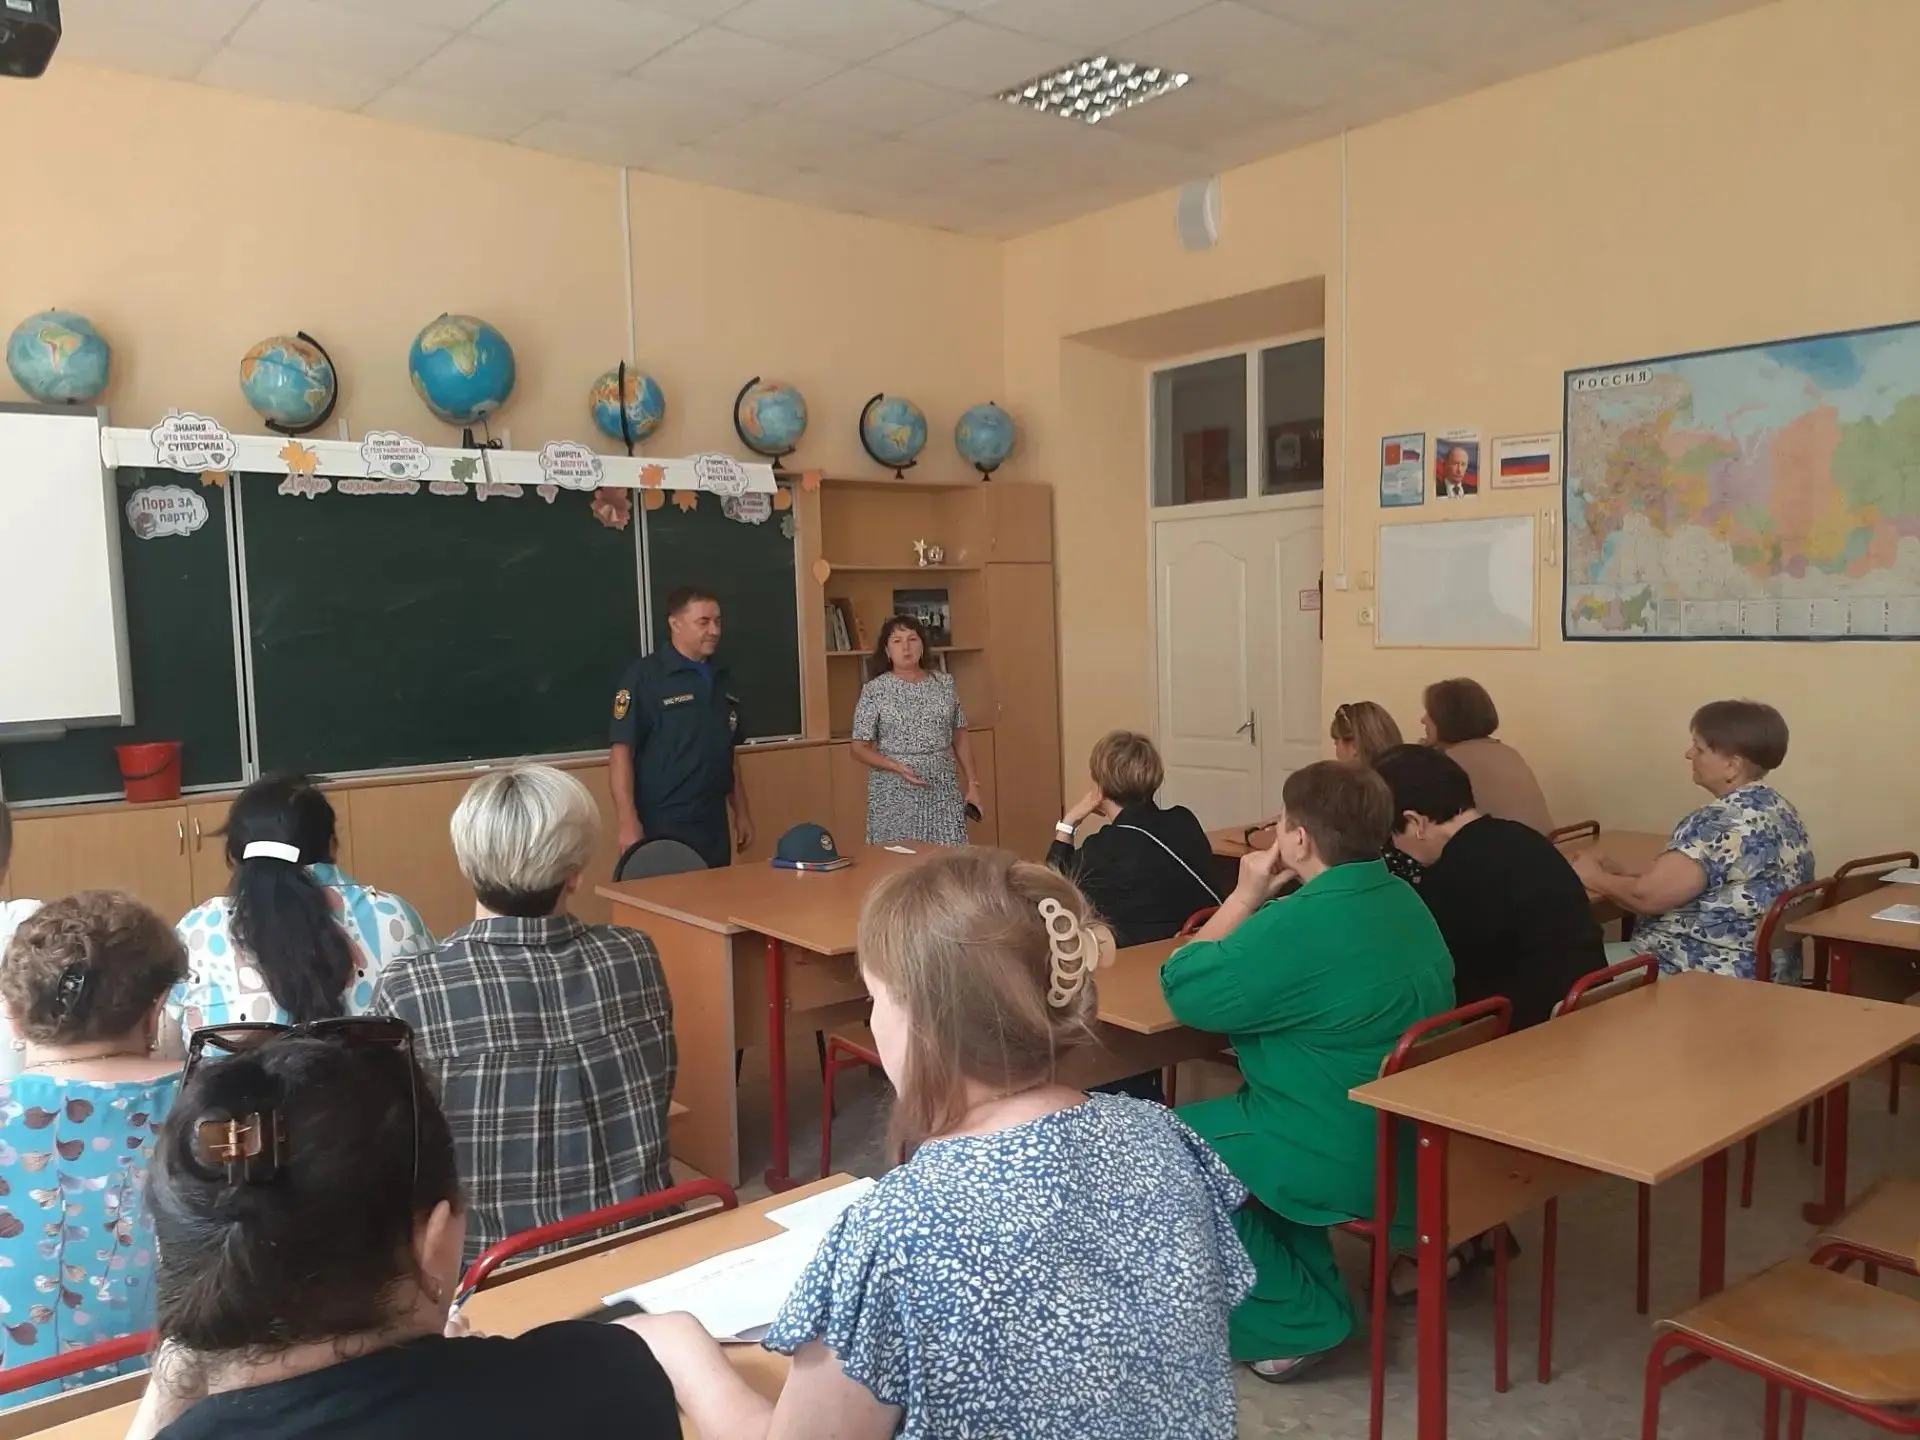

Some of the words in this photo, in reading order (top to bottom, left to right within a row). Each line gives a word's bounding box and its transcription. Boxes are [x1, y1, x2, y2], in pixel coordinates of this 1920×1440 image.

[1577, 370, 1647, 390] РОССИЯ
[173, 423, 207, 432] ЗНАНИЯ
[167, 442, 225, 452] СУПЕРСИЛА!
[141, 496, 175, 511] Пора
[159, 509, 198, 524] парту!
